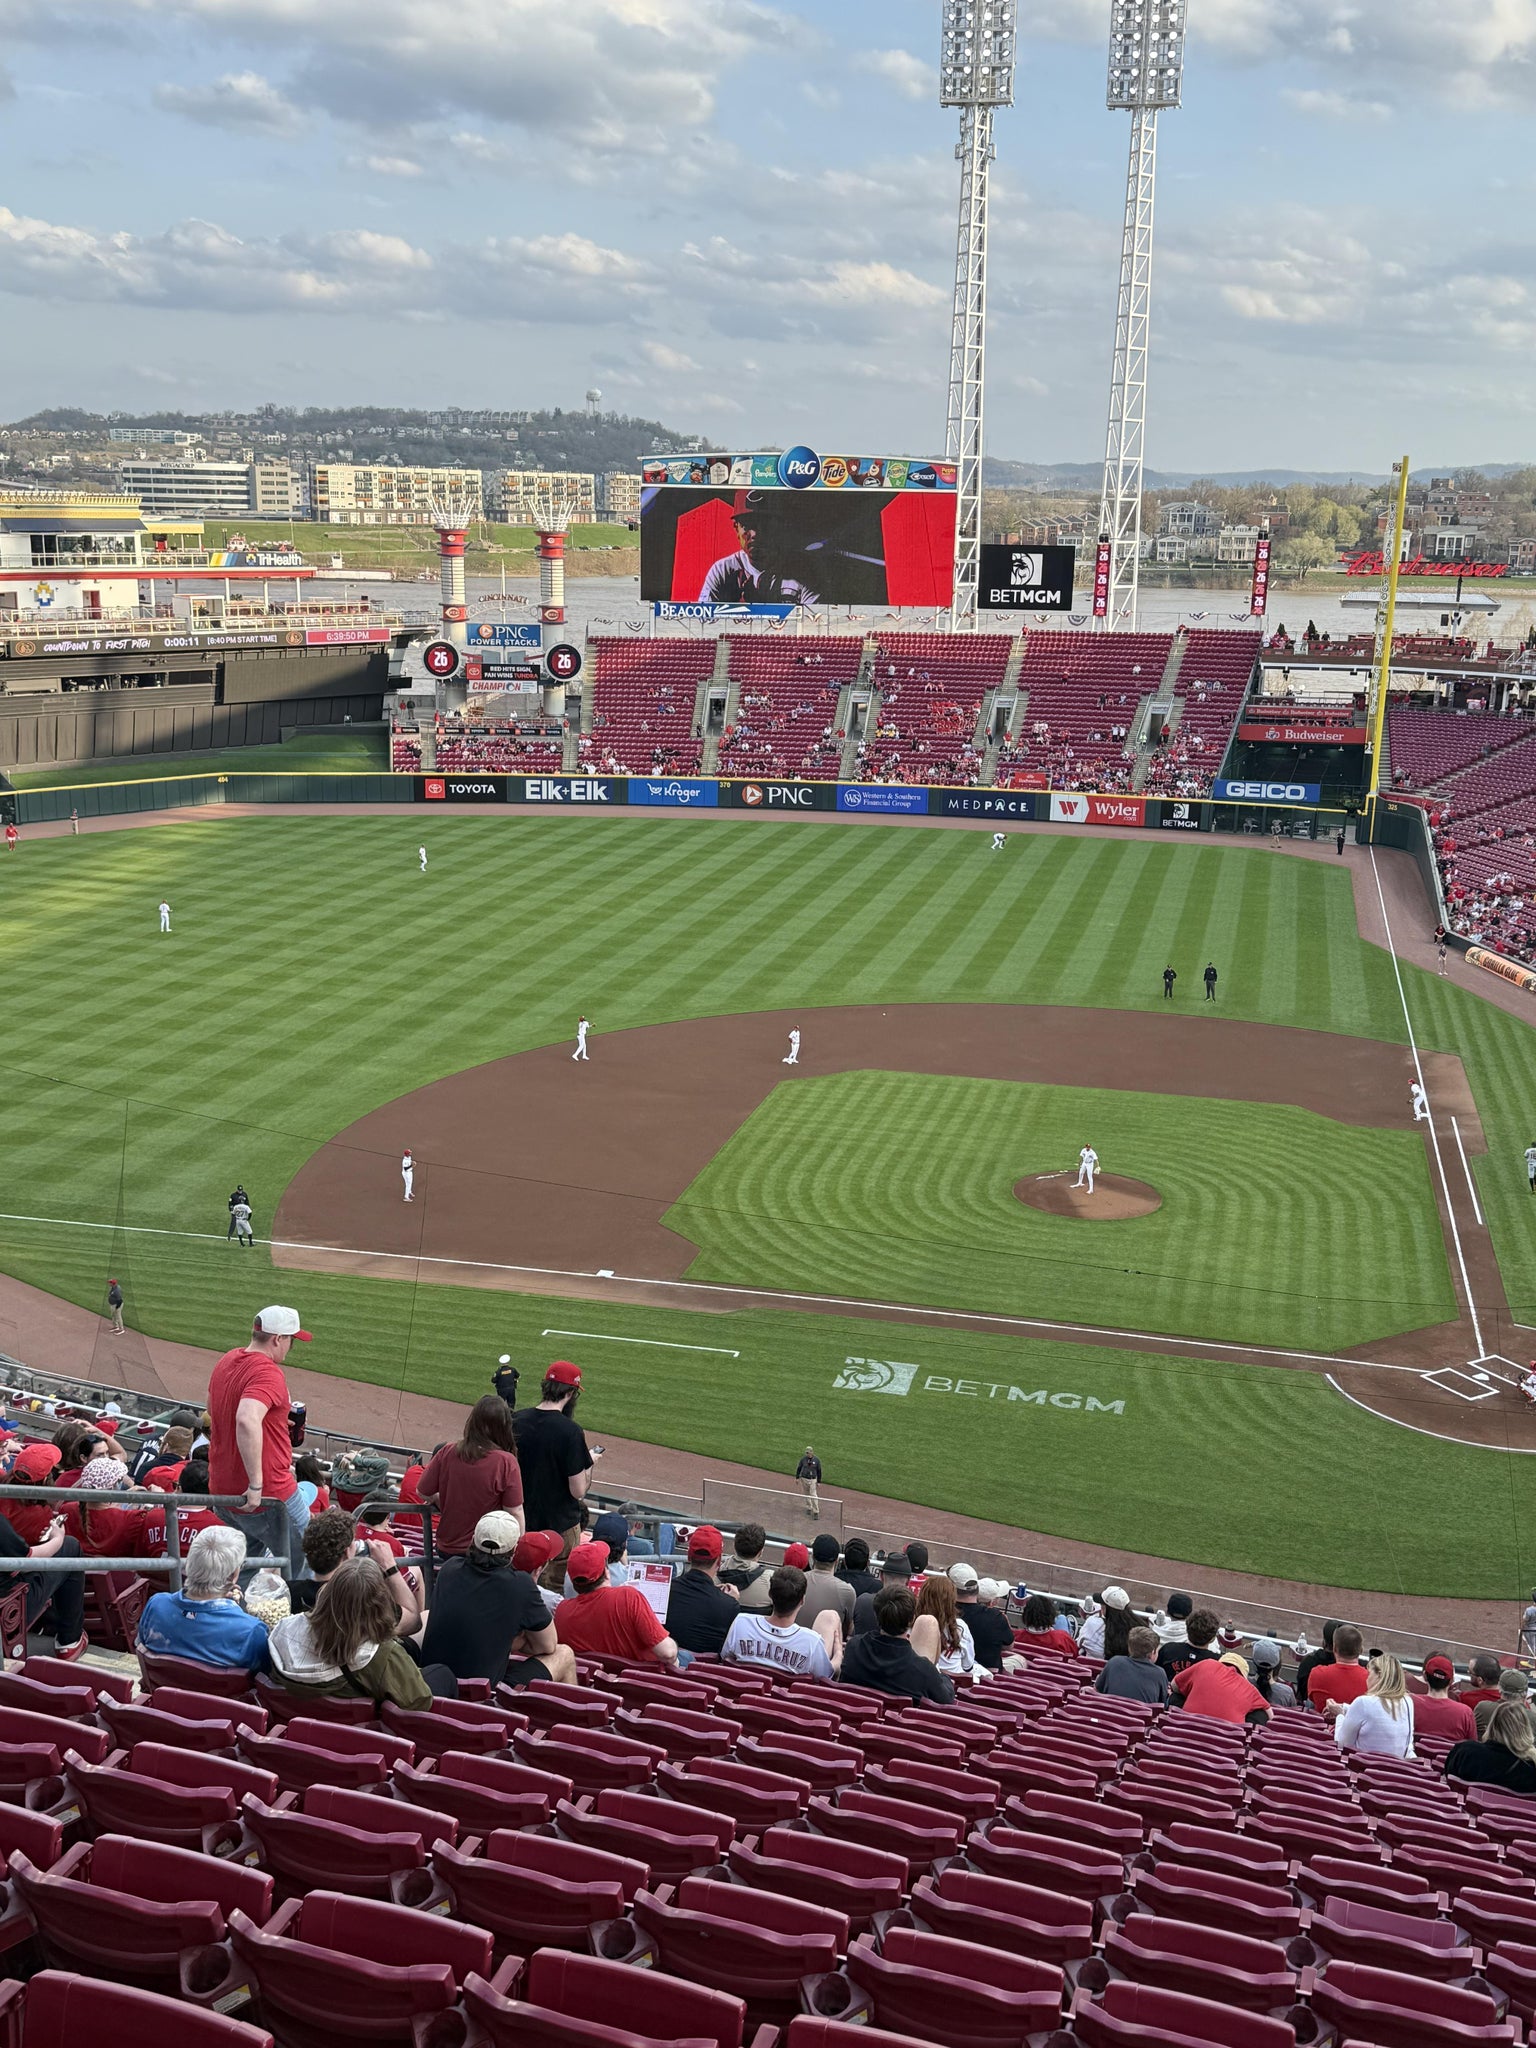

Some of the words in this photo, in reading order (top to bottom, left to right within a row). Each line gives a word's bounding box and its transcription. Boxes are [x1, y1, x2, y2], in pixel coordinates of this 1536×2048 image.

[787, 460, 816, 475] P&G
[822, 465, 846, 481] Tide
[257, 553, 302, 566] TriHealth
[1099, 551, 1109, 561] 26
[1259, 549, 1268, 559] 26
[1097, 574, 1107, 584] 26
[1256, 572, 1266, 583] 26
[990, 589, 1061, 604] BETMGM
[1096, 597, 1105, 608] 26
[1254, 596, 1264, 607] 26
[660, 602, 715, 618] BEACON
[326, 632, 357, 641] 6:39:50
[357, 631, 370, 640] PM
[494, 626, 529, 639] PNC
[43, 640, 89, 652] COUNTDOWN
[92, 639, 101, 649] TO
[105, 638, 131, 650] FIRST
[131, 637, 151, 649] PITCH
[164, 637, 199, 647] 0:00:11
[225, 636, 237, 644] PM
[237, 635, 260, 643] START
[434, 651, 448, 667] 26
[557, 654, 571, 669] 26
[1284, 729, 1345, 741] Budweiser
[449, 784, 496, 794] TOYOTA
[525, 779, 608, 801] Elk+Elk
[664, 782, 701, 803] Kroger
[766, 786, 813, 805] PNC
[862, 791, 886, 799] Western
[887, 792, 893, 800] &
[894, 792, 921, 800] Southern
[1225, 781, 1306, 800] GEICO
[891, 800, 912, 808] Group
[1059, 801, 1079, 815] W
[1387, 803, 1398, 811] 325
[1094, 802, 1140, 820] Wyler
[1162, 819, 1198, 828] BETMGM
[1482, 956, 1505, 975] GORILLA
[1504, 966, 1520, 982] GLUE
[923, 1376, 1126, 1415] BETMGM
[148, 1527, 161, 1544] DE
[180, 1527, 200, 1543] CR
[739, 1639, 754, 1657] DE
[756, 1640, 773, 1660] LA
[773, 1645, 809, 1669] CRUZ
